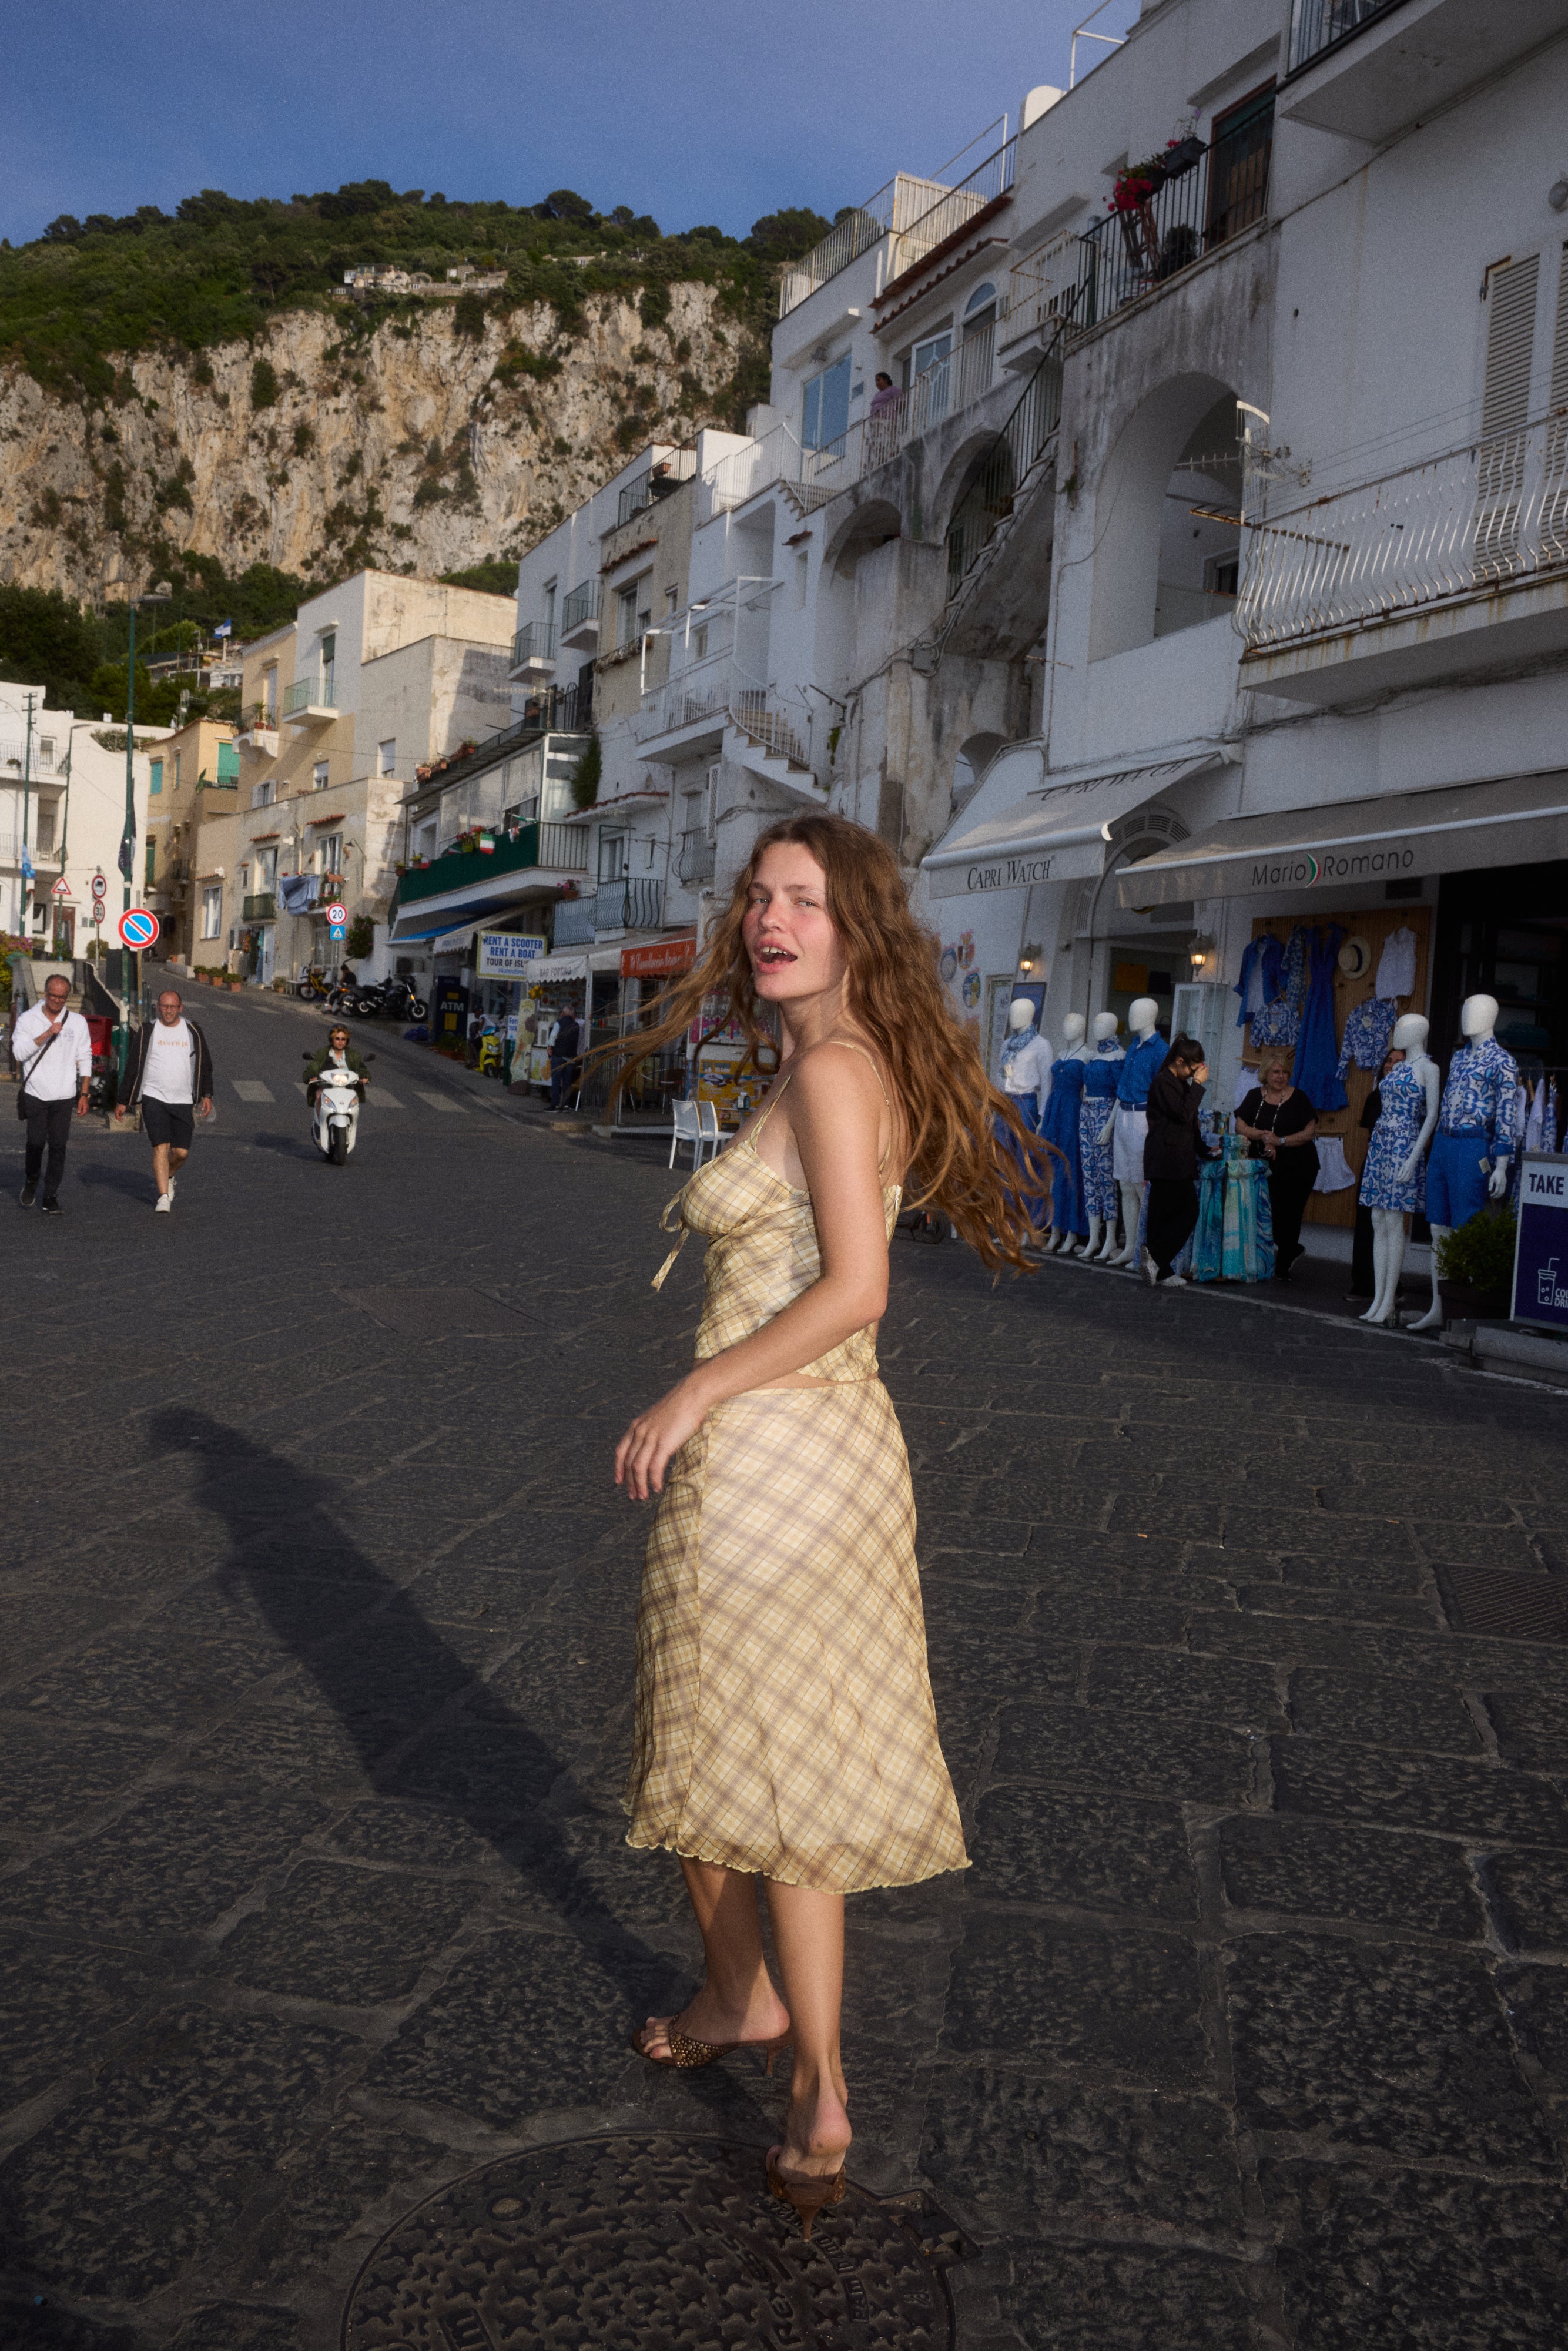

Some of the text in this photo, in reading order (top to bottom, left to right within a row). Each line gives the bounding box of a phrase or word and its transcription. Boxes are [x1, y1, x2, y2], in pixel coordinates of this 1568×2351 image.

[1252, 850, 1414, 886] Mario Romano
[967, 868, 1001, 890] CAPRI
[333, 910, 343, 919] 20
[484, 936, 543, 950] RENT A SCOOTER
[490, 947, 535, 959] RENT A BOAT
[487, 958, 503, 966] TOUR
[540, 968, 549, 977] BAR
[440, 1002, 464, 1012] ATM
[1529, 1174, 1564, 1195] TAKE
[1554, 1297, 1568, 1308] DRI
